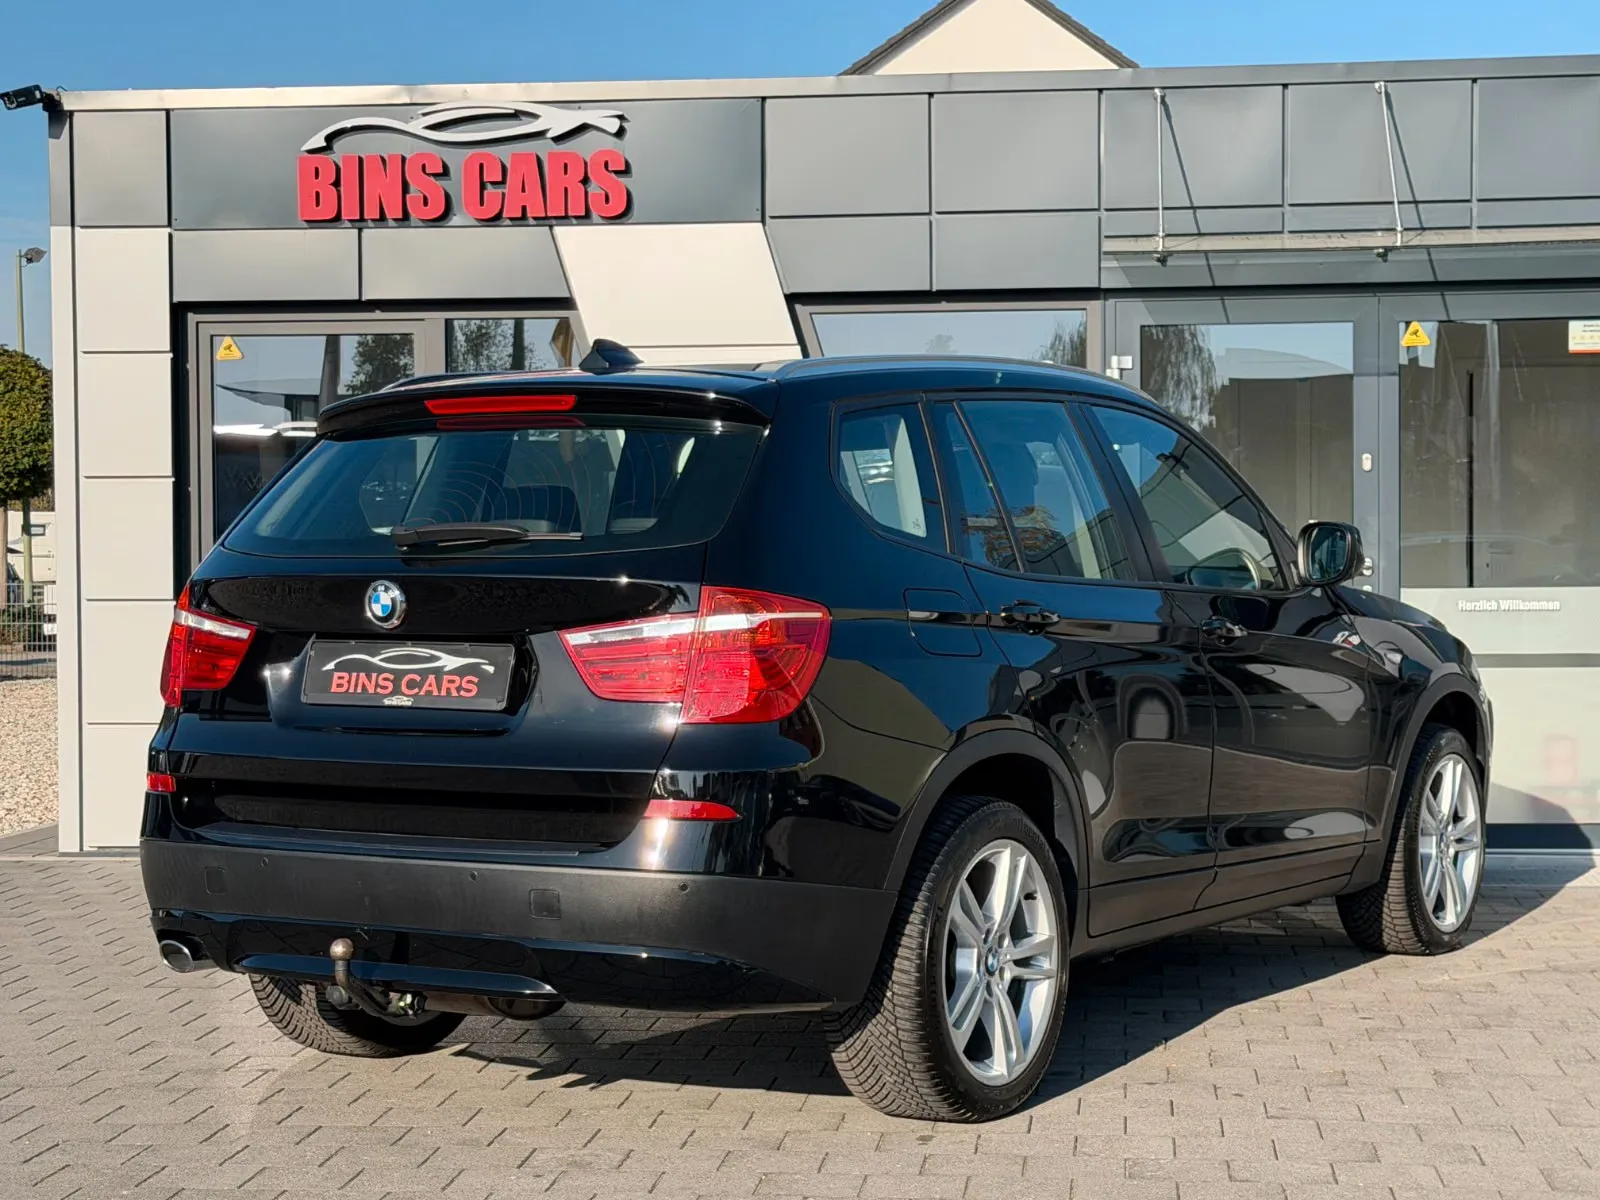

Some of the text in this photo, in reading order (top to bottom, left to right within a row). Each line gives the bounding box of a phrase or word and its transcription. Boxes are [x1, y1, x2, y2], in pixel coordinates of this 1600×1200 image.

[297, 149, 629, 221] BINS CARS
[1458, 599, 1560, 611] Herzlich Willkommen
[330, 671, 479, 698] BINS CARS
